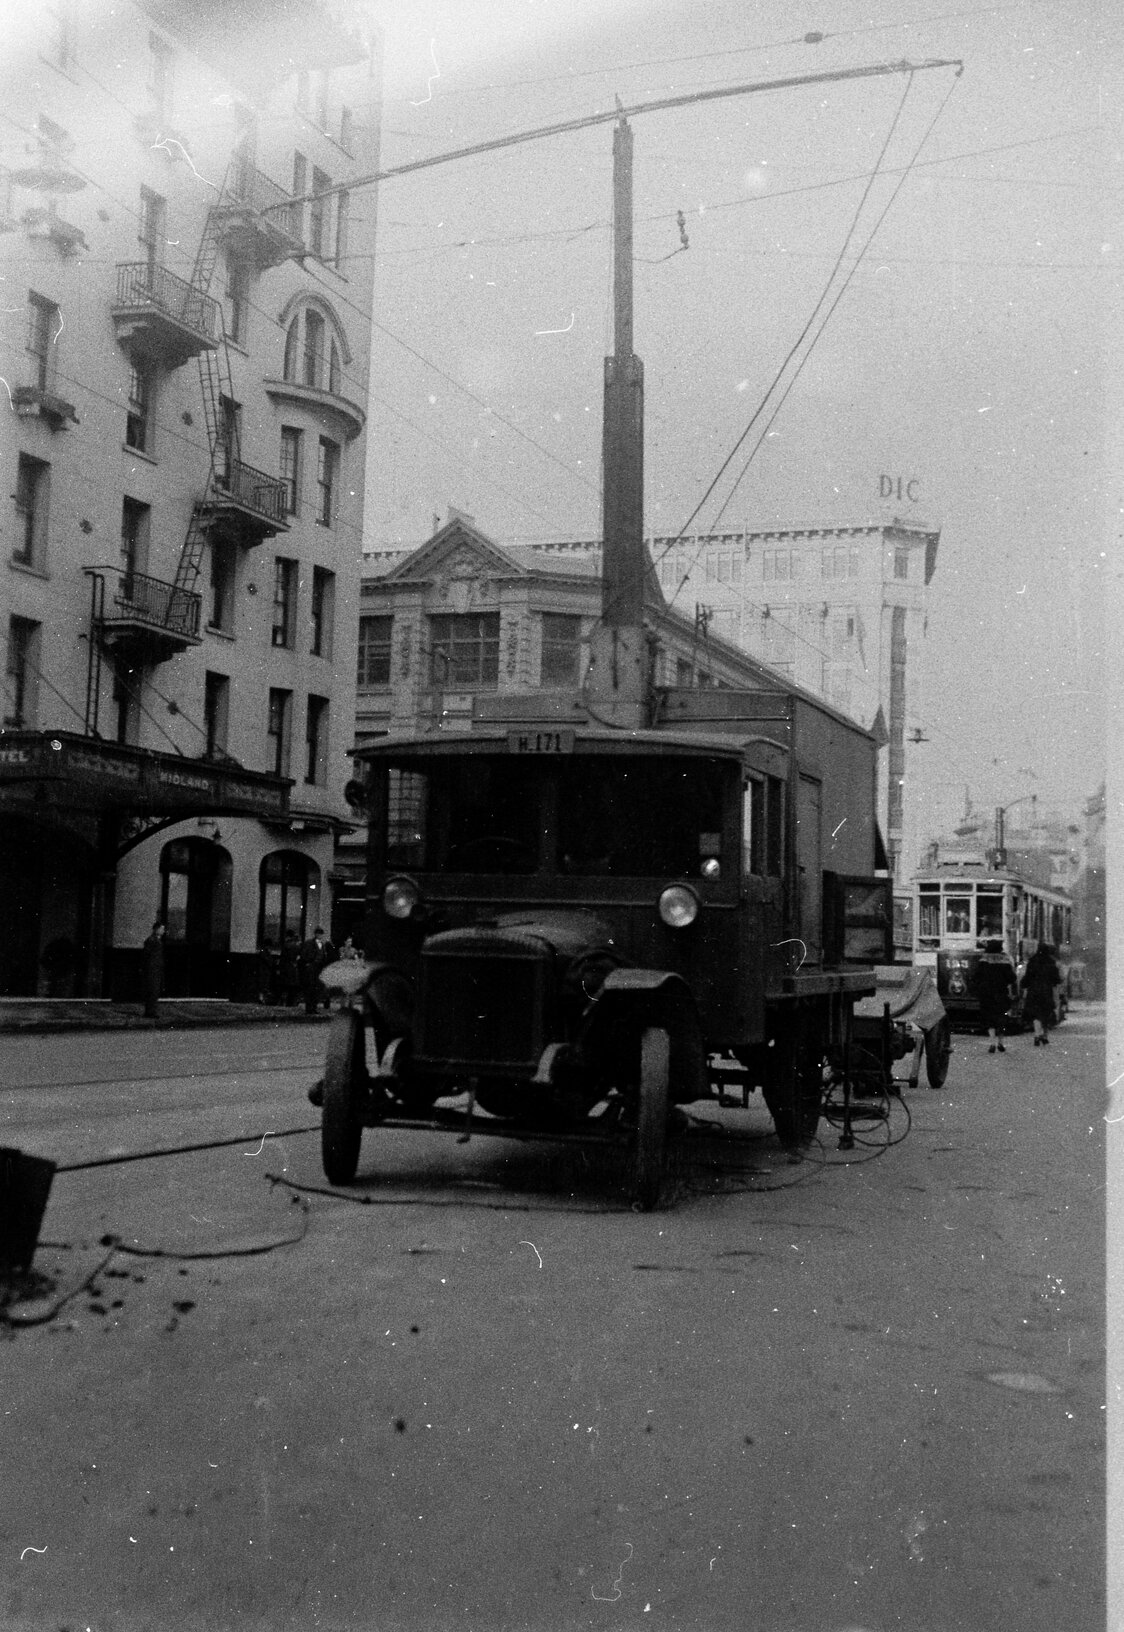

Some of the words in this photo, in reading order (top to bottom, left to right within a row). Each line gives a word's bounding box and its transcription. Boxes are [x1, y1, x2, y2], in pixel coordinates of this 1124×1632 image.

[880, 474, 919, 503] DIC
[0, 750, 29, 761] TEL
[159, 771, 209, 790] MIDLAND
